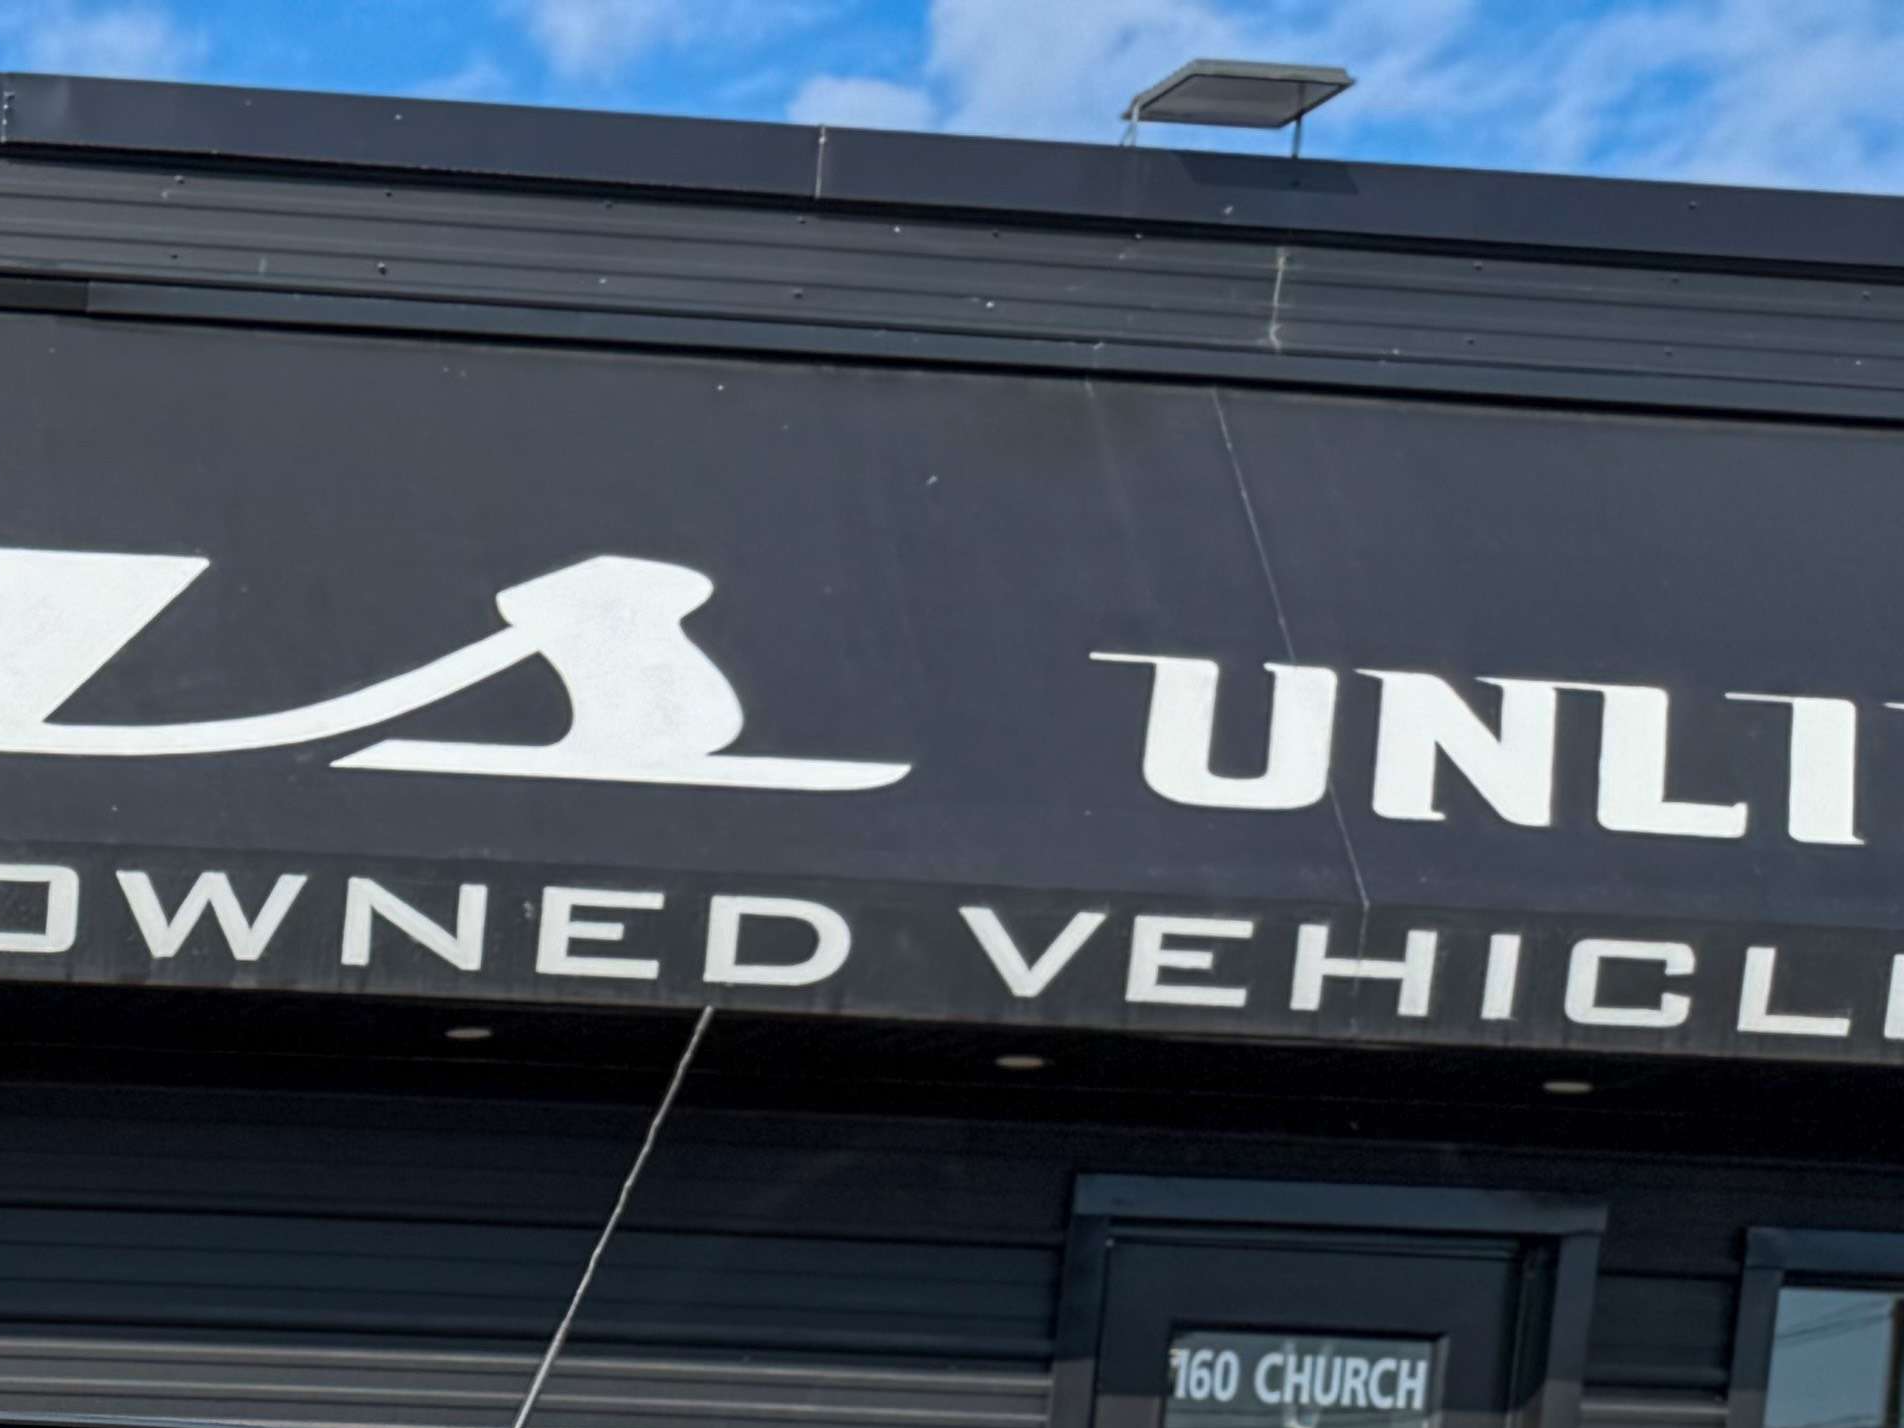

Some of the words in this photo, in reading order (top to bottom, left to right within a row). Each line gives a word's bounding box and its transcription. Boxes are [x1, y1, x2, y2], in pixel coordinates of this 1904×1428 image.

[1089, 652, 1904, 845] UNLI
[958, 905, 1904, 1040] VEHICL
[1173, 1348, 1240, 1401] 160
[1254, 1353, 1429, 1410] CHURCH
